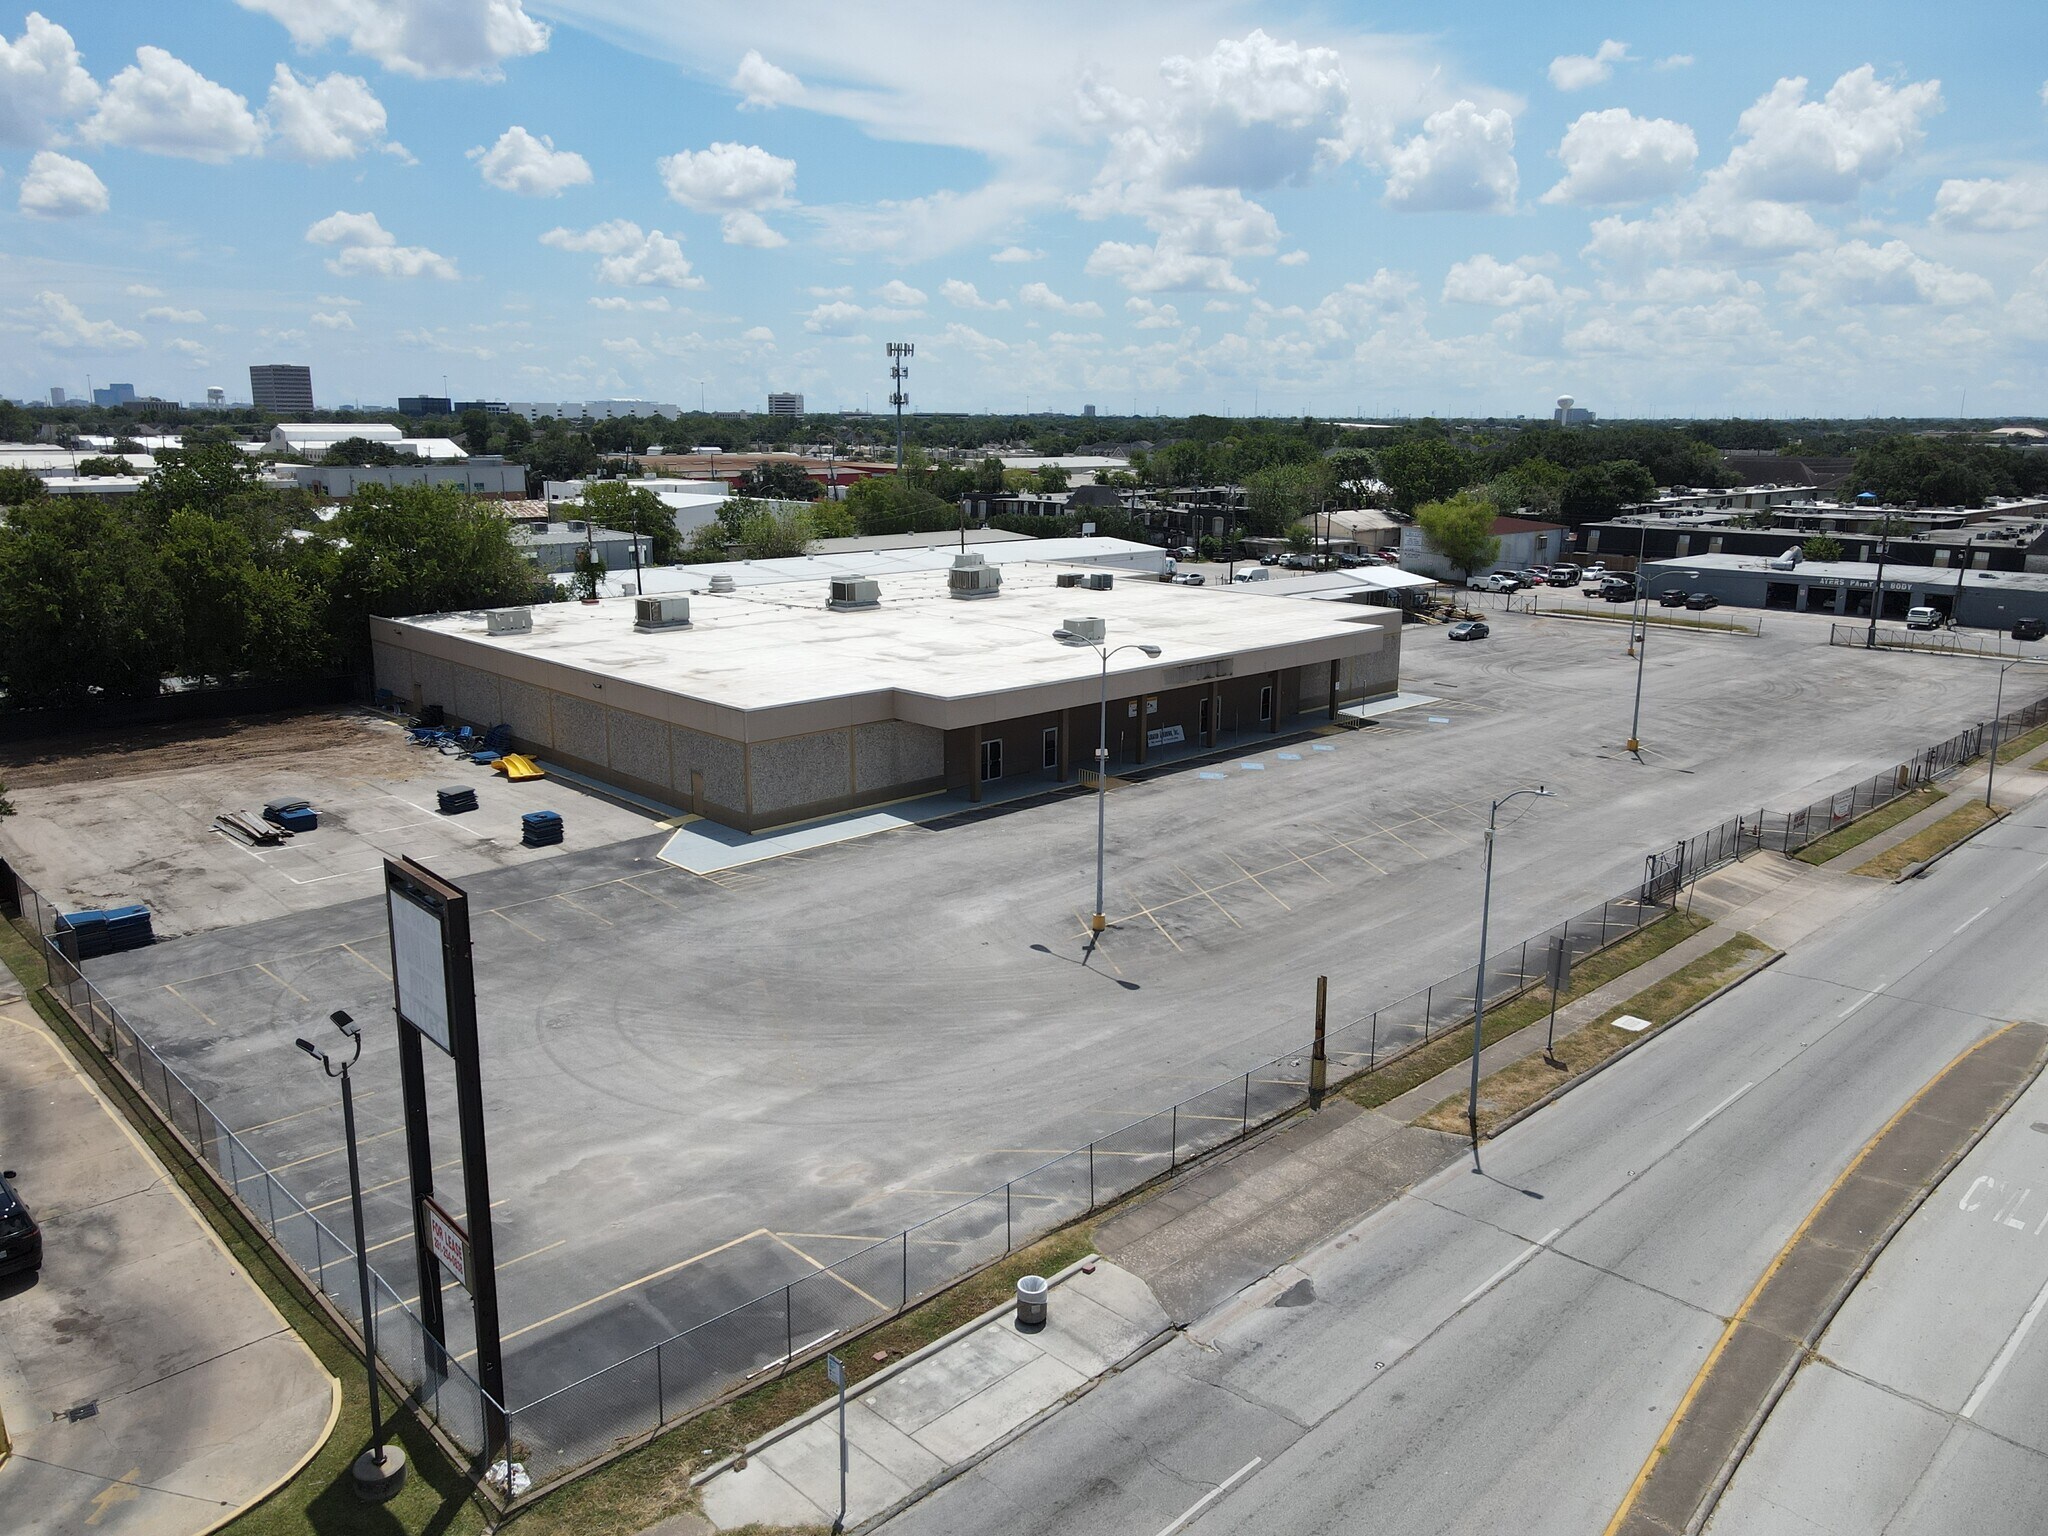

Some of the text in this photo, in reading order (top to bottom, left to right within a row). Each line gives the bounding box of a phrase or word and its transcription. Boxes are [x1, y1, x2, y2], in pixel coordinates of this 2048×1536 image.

[1819, 578, 1845, 586] AYERS
[1890, 583, 1913, 591] BODY
[432, 1219, 463, 1261] FOR LEASE
